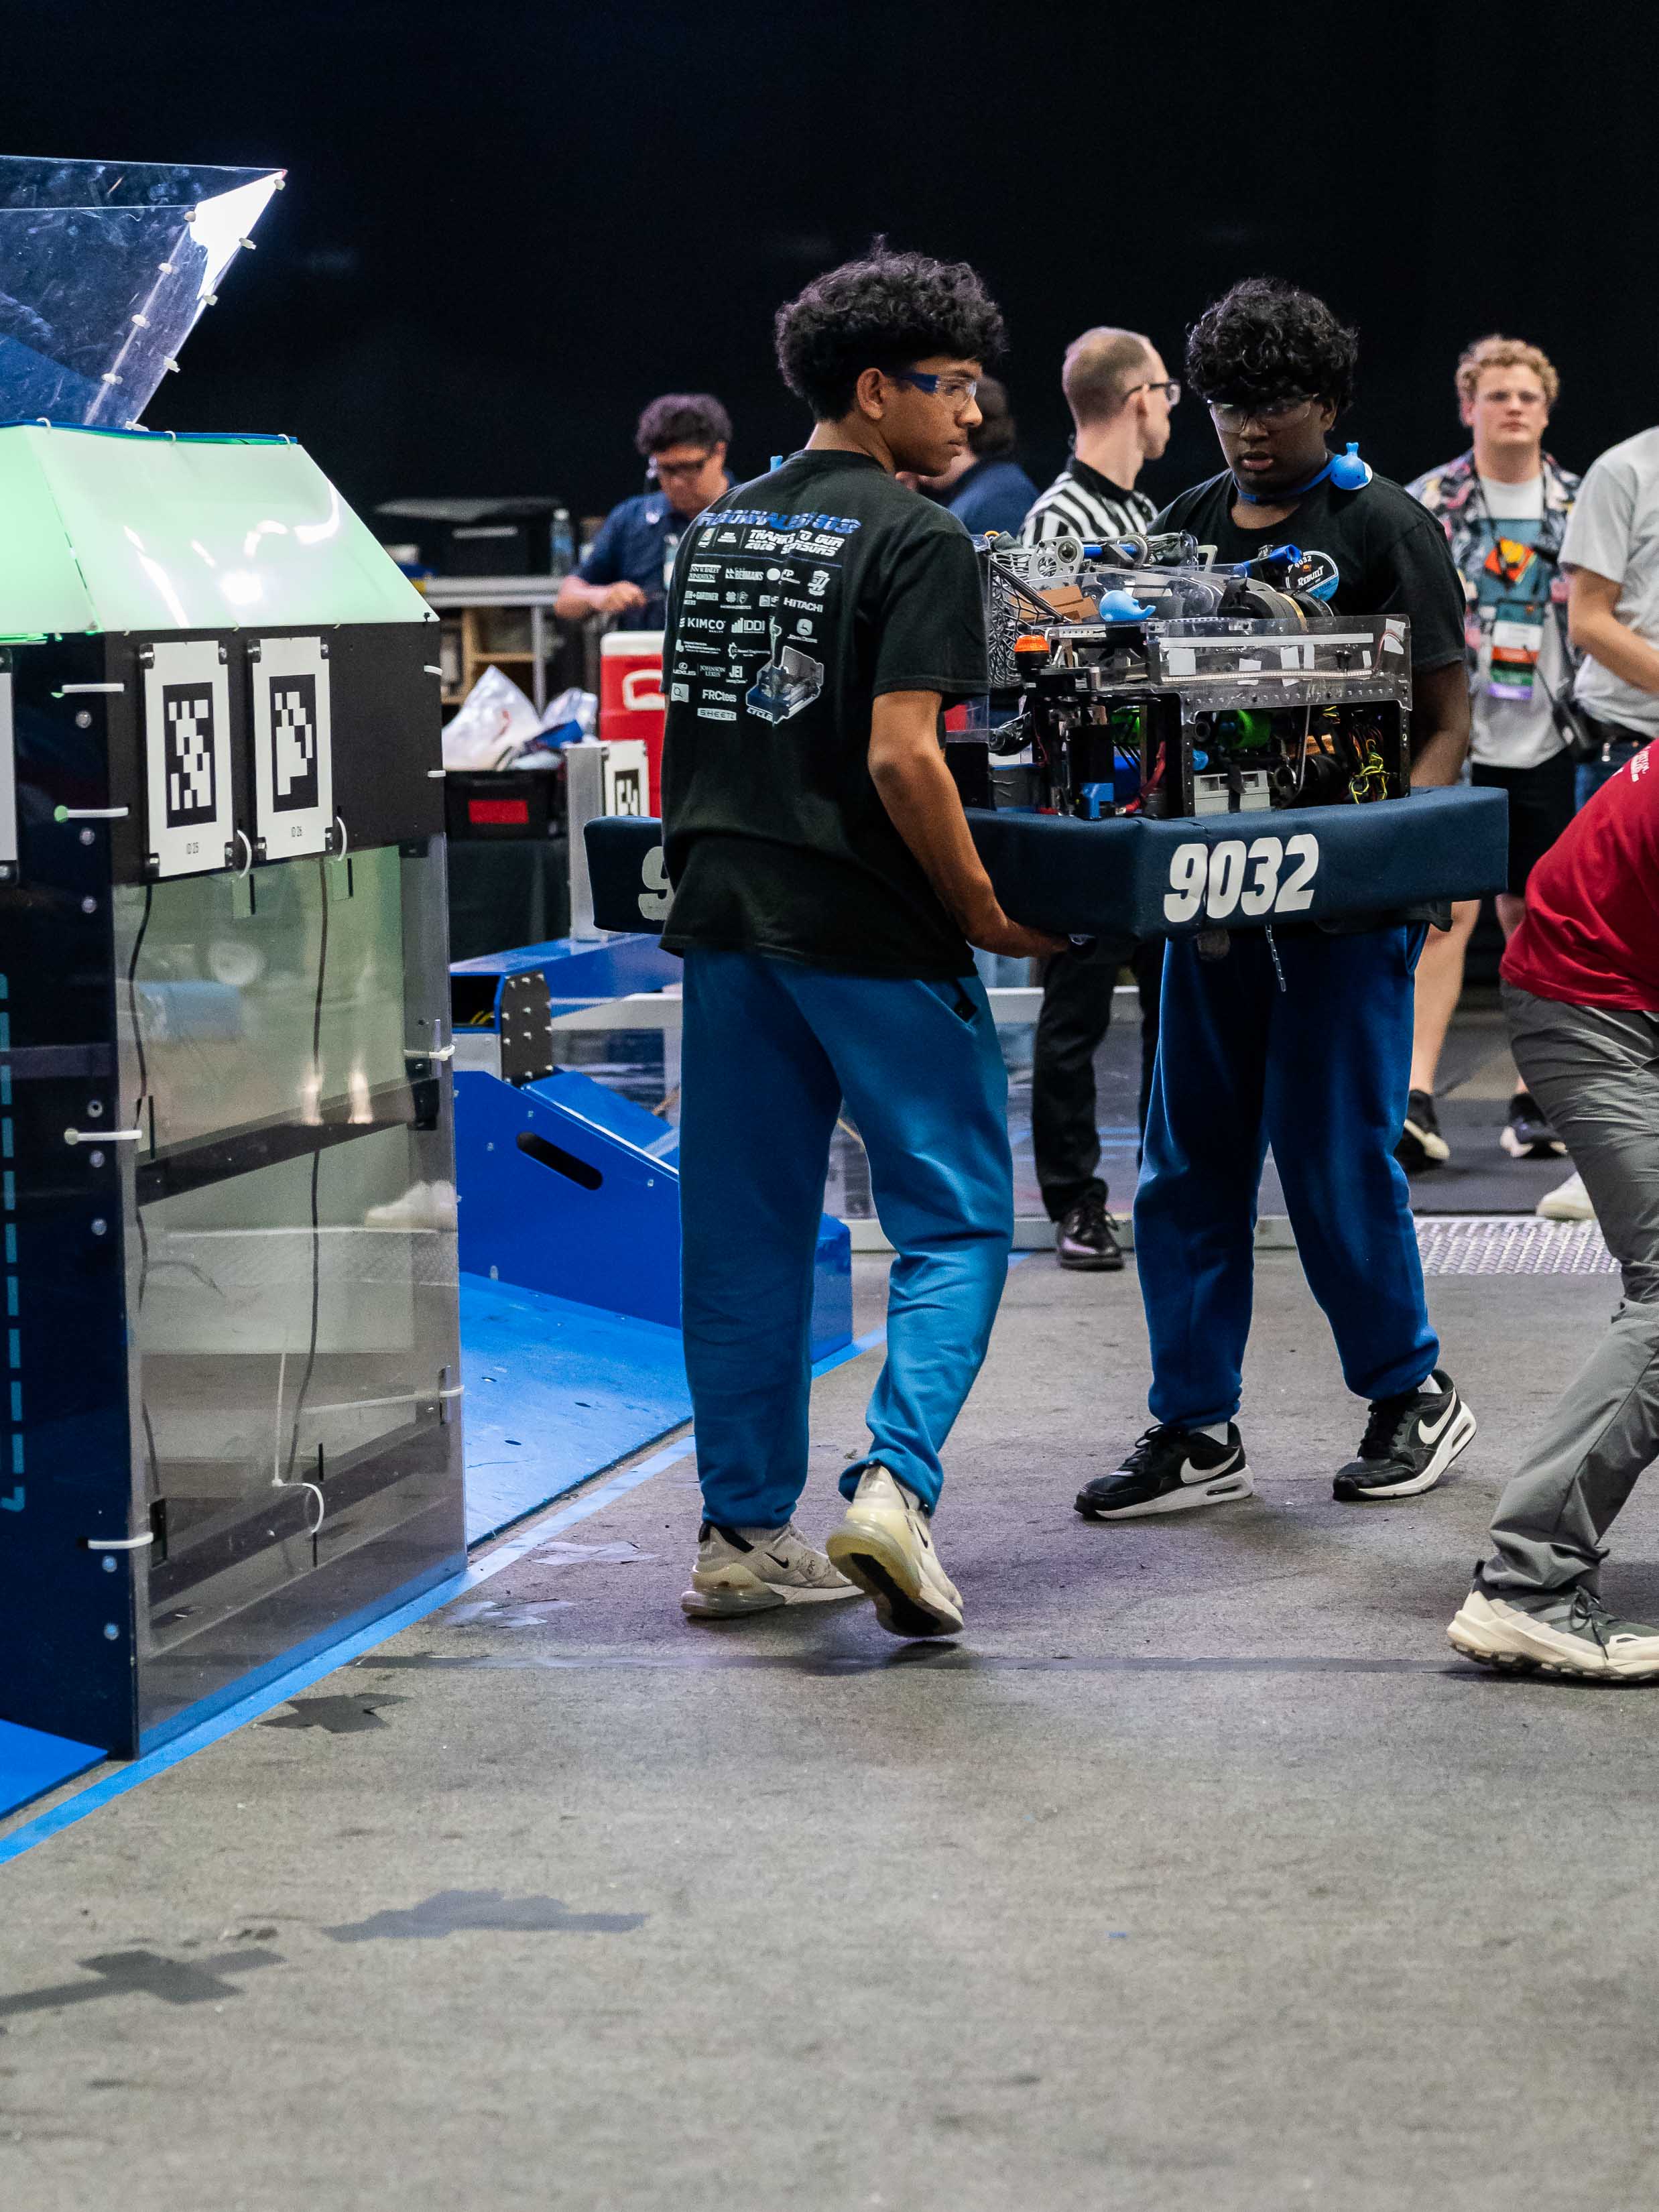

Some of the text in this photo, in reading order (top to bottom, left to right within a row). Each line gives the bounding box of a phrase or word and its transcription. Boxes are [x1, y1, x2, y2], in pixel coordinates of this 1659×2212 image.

[780, 539, 839, 557] SPNSORS
[814, 534, 845, 548] OUR
[1294, 555, 1312, 568] 9032
[1297, 565, 1325, 586] REBUILT
[783, 597, 824, 613] HITACHI
[687, 617, 725, 630] KIMCO
[700, 664, 726, 673] JOHNSON
[702, 688, 737, 702] FRCtees
[698, 709, 735, 720] SHEETZ
[1163, 833, 1320, 923] 9032
